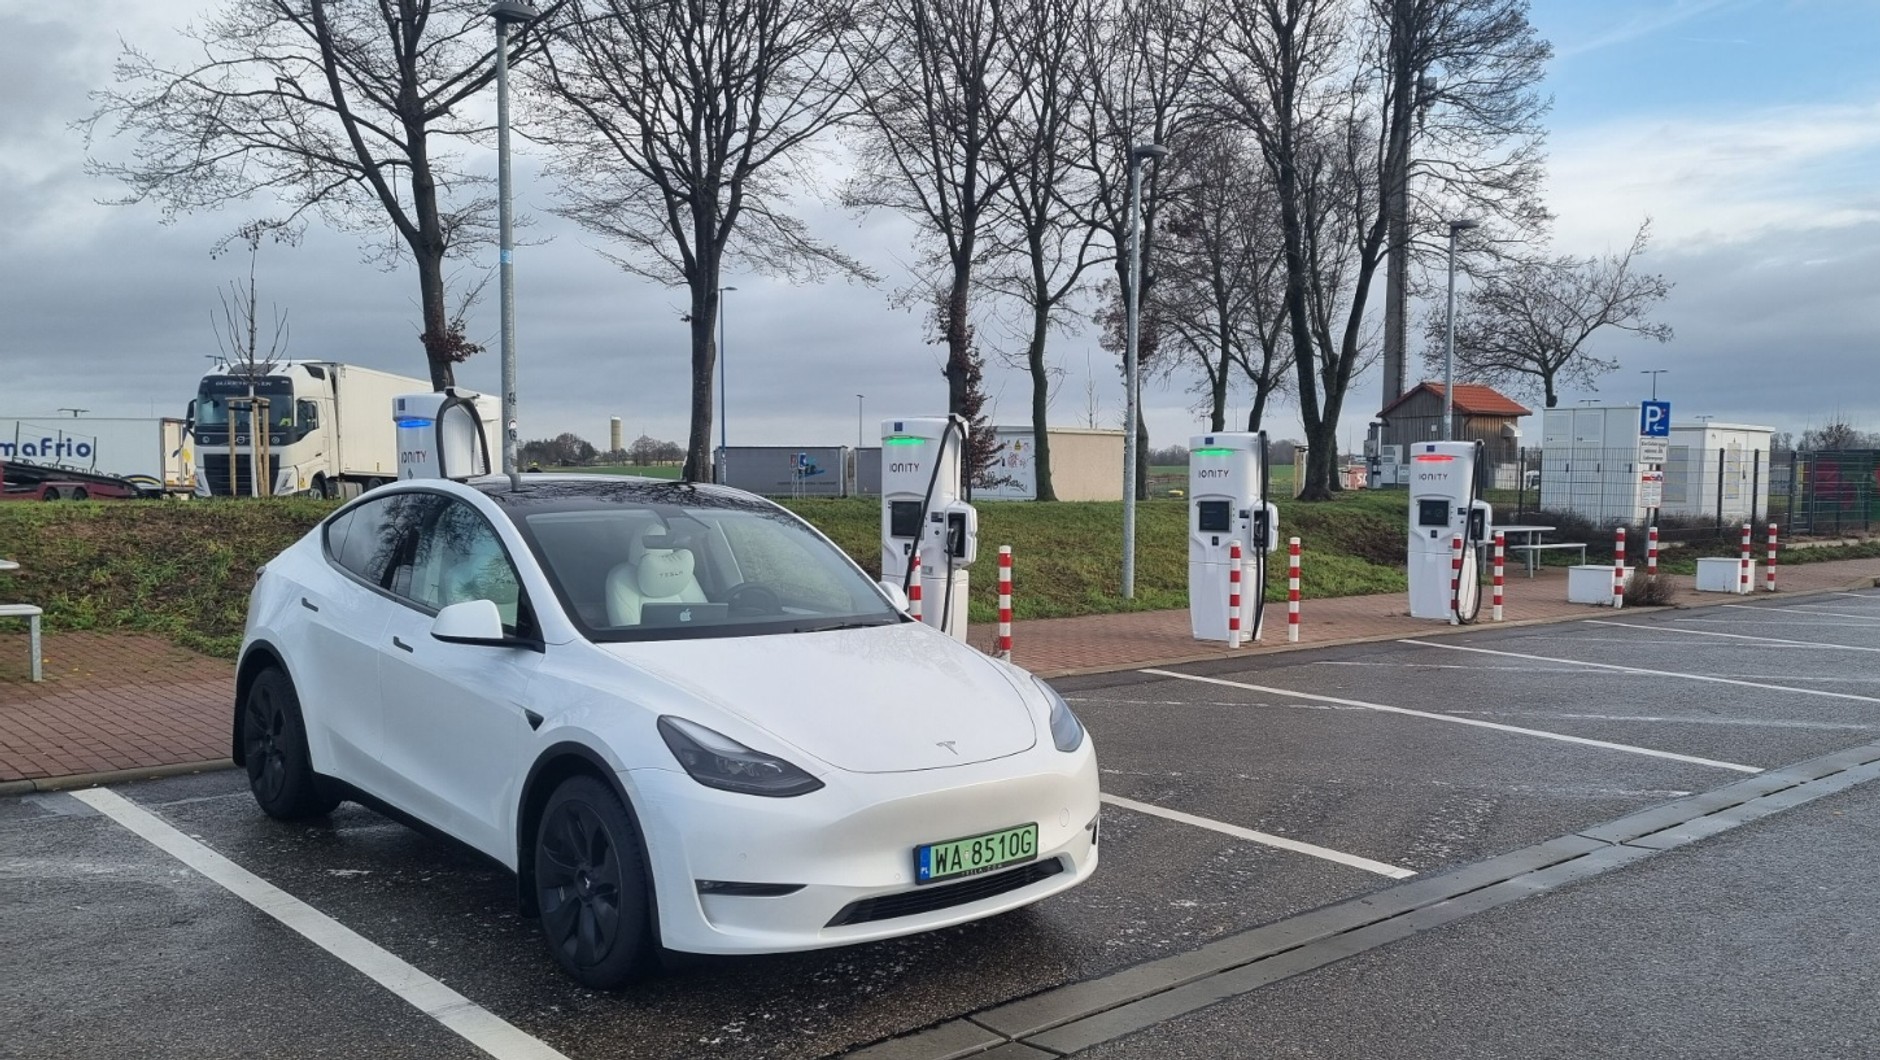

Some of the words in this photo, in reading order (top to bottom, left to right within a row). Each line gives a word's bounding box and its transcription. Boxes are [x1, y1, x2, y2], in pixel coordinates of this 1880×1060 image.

[1645, 405, 1661, 432] P
[401, 450, 427, 463] IONITY
[889, 463, 920, 473] IONITY
[1198, 469, 1230, 479] IONITY
[1418, 473, 1449, 481] IONITY
[935, 844, 963, 875] WA
[971, 829, 1033, 867] 8510G
[920, 866, 929, 875] PL
